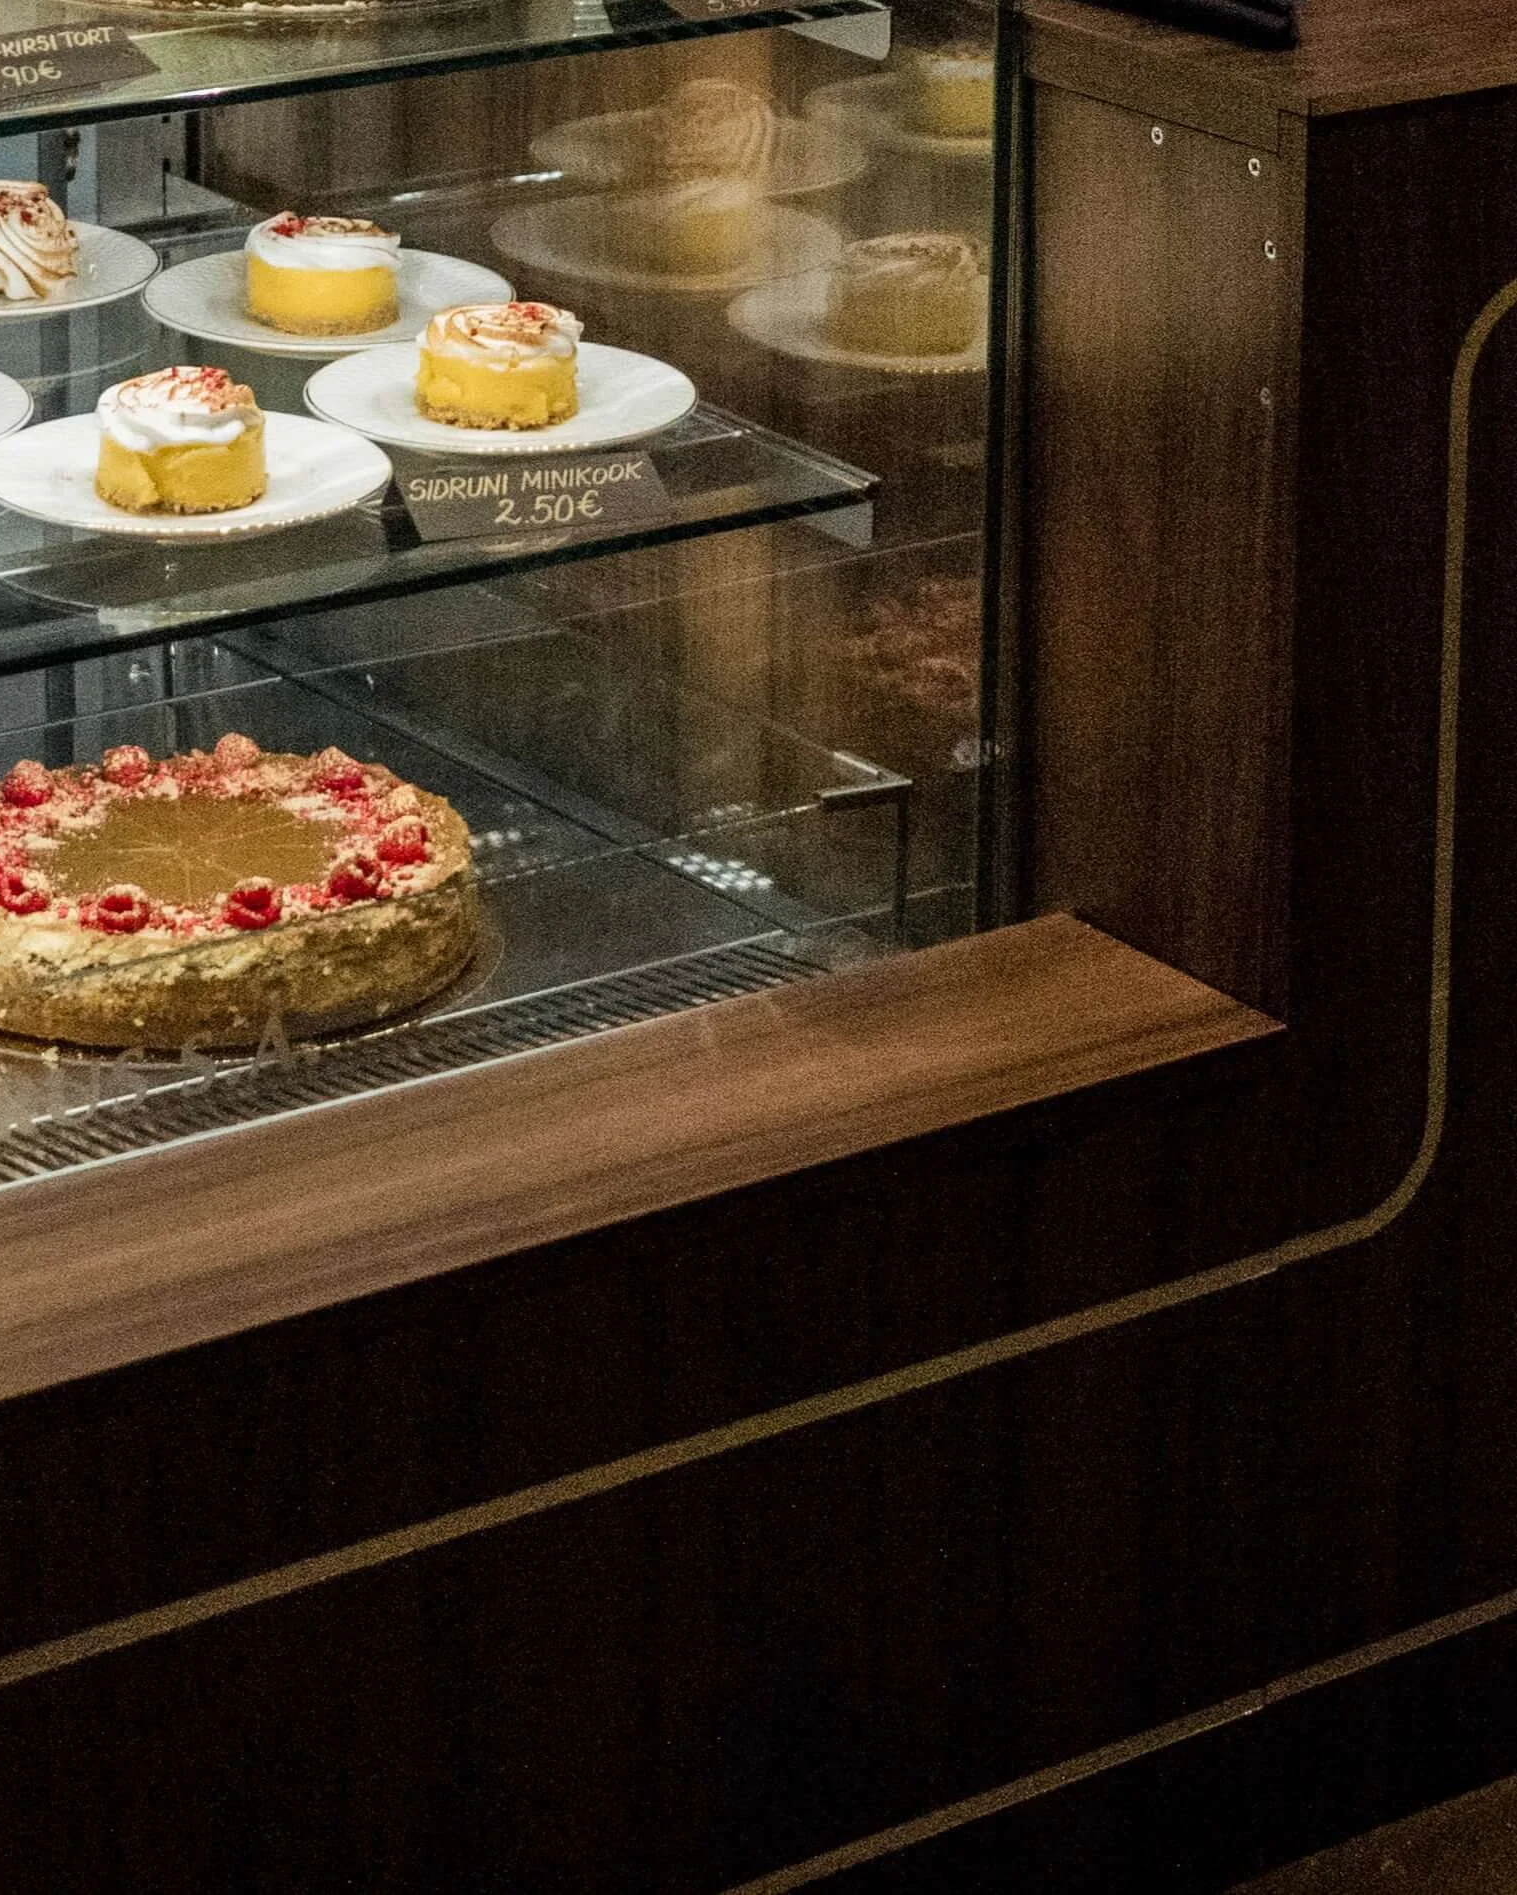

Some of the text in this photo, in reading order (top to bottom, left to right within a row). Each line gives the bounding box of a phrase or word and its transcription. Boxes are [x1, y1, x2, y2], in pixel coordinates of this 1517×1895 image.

[57, 26, 115, 49] TORT
[408, 460, 645, 502] SIDRUNI MINIKOOK
[493, 489, 604, 525] 2.50€
